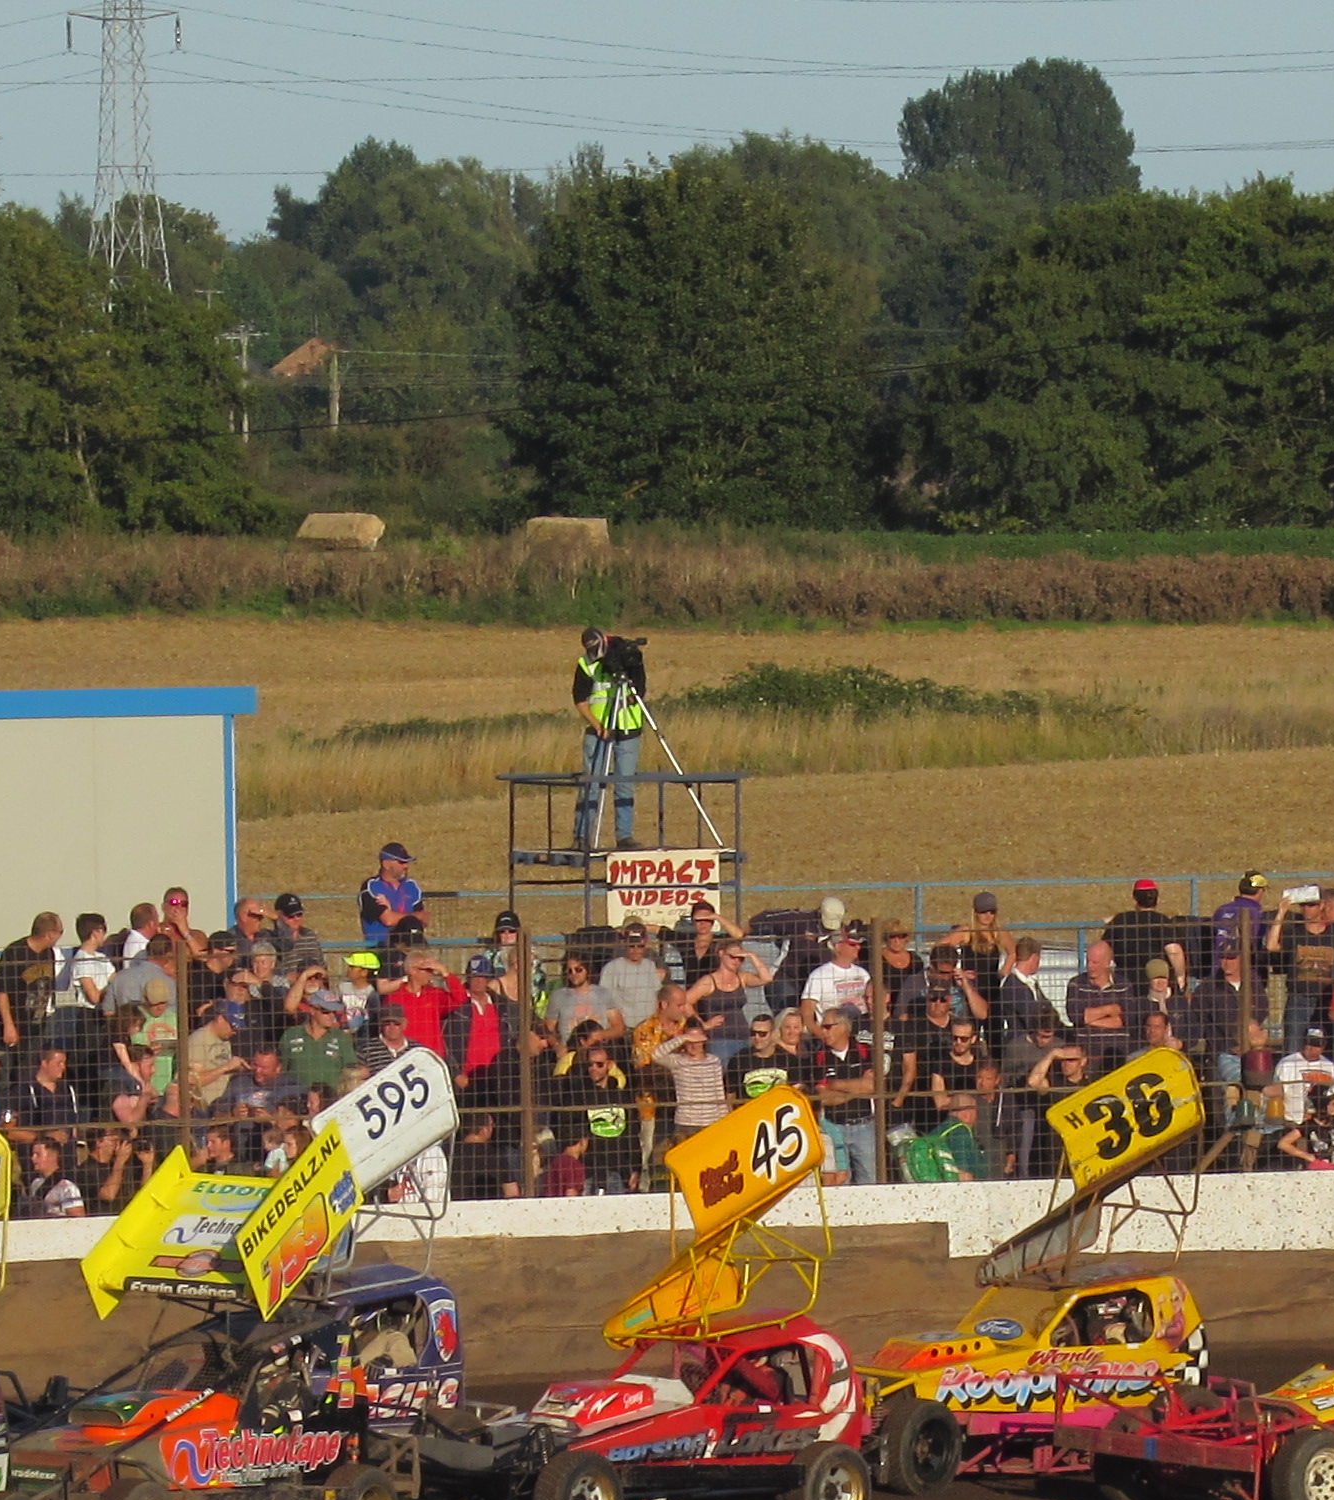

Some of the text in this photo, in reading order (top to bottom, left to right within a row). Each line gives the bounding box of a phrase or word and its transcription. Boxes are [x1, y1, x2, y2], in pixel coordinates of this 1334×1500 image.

[610, 859, 715, 884] IMPACT
[618, 890, 705, 906] VIDEOS
[356, 1063, 431, 1141] 595
[1064, 1073, 1174, 1160] H 36
[752, 1104, 805, 1182] 45
[241, 1133, 342, 1259] BIKEDEALZ.NL
[980, 1320, 1015, 1337] Ford
[1027, 1346, 1105, 1367] Wendy
[200, 1426, 345, 1473] Technotape
